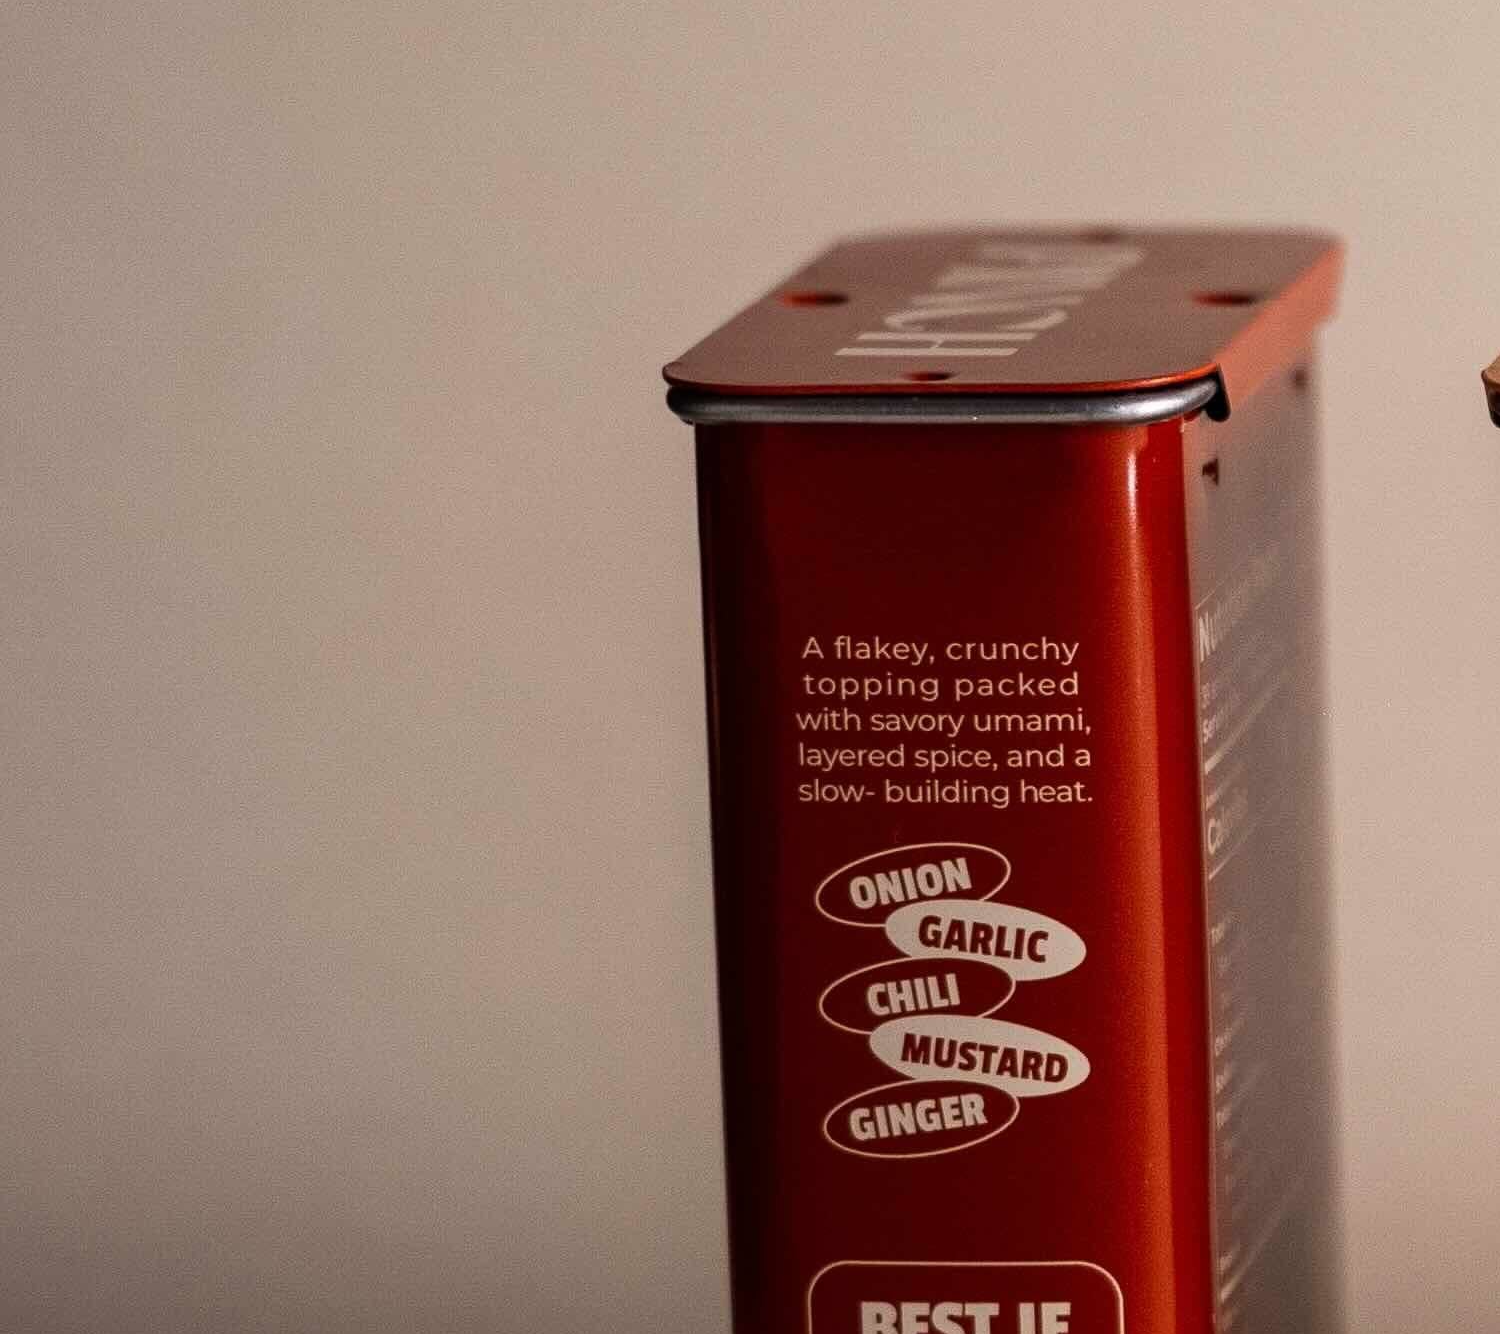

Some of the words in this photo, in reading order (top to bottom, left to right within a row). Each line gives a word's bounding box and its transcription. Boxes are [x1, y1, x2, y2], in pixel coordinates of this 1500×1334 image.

[802, 636, 825, 659] A
[833, 635, 935, 666] flakey,
[945, 636, 1080, 666] crunchy
[803, 671, 939, 702] topping
[955, 670, 1079, 702] packed
[795, 706, 862, 731] with
[870, 713, 965, 738] savory
[973, 706, 1092, 735] umami,
[848, 857, 973, 911] ONION
[917, 914, 1050, 964] GARLIC
[866, 972, 961, 1017] CHILI
[900, 1032, 1069, 1083] MUSTARD
[849, 1092, 988, 1143] GINGER
